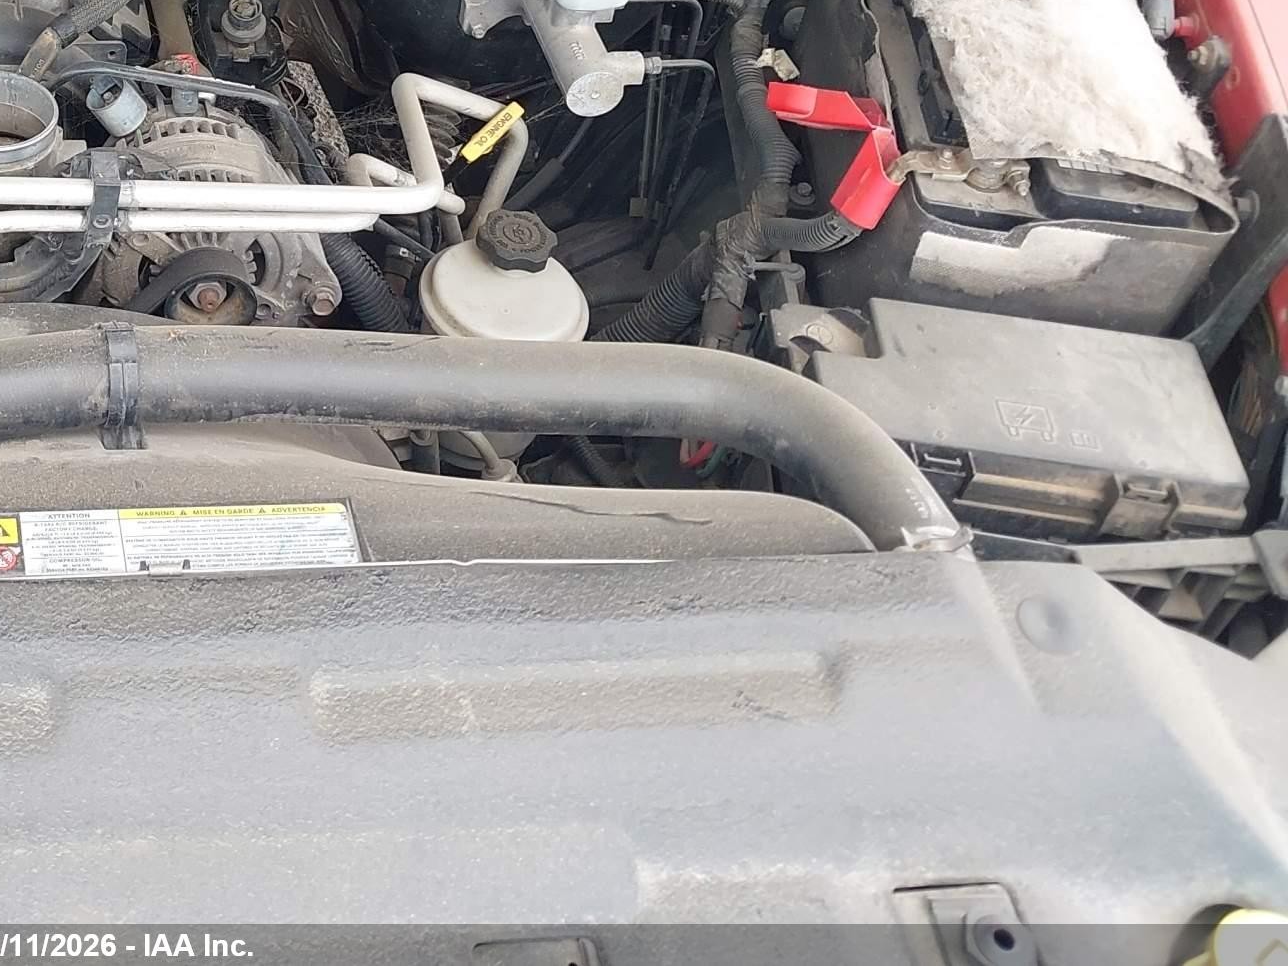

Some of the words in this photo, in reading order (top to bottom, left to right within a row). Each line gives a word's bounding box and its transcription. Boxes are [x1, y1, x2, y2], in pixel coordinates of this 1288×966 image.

[487, 112, 513, 139] ENGINE
[473, 135, 489, 147] OIL
[271, 506, 326, 514] ADVERTENCIA
